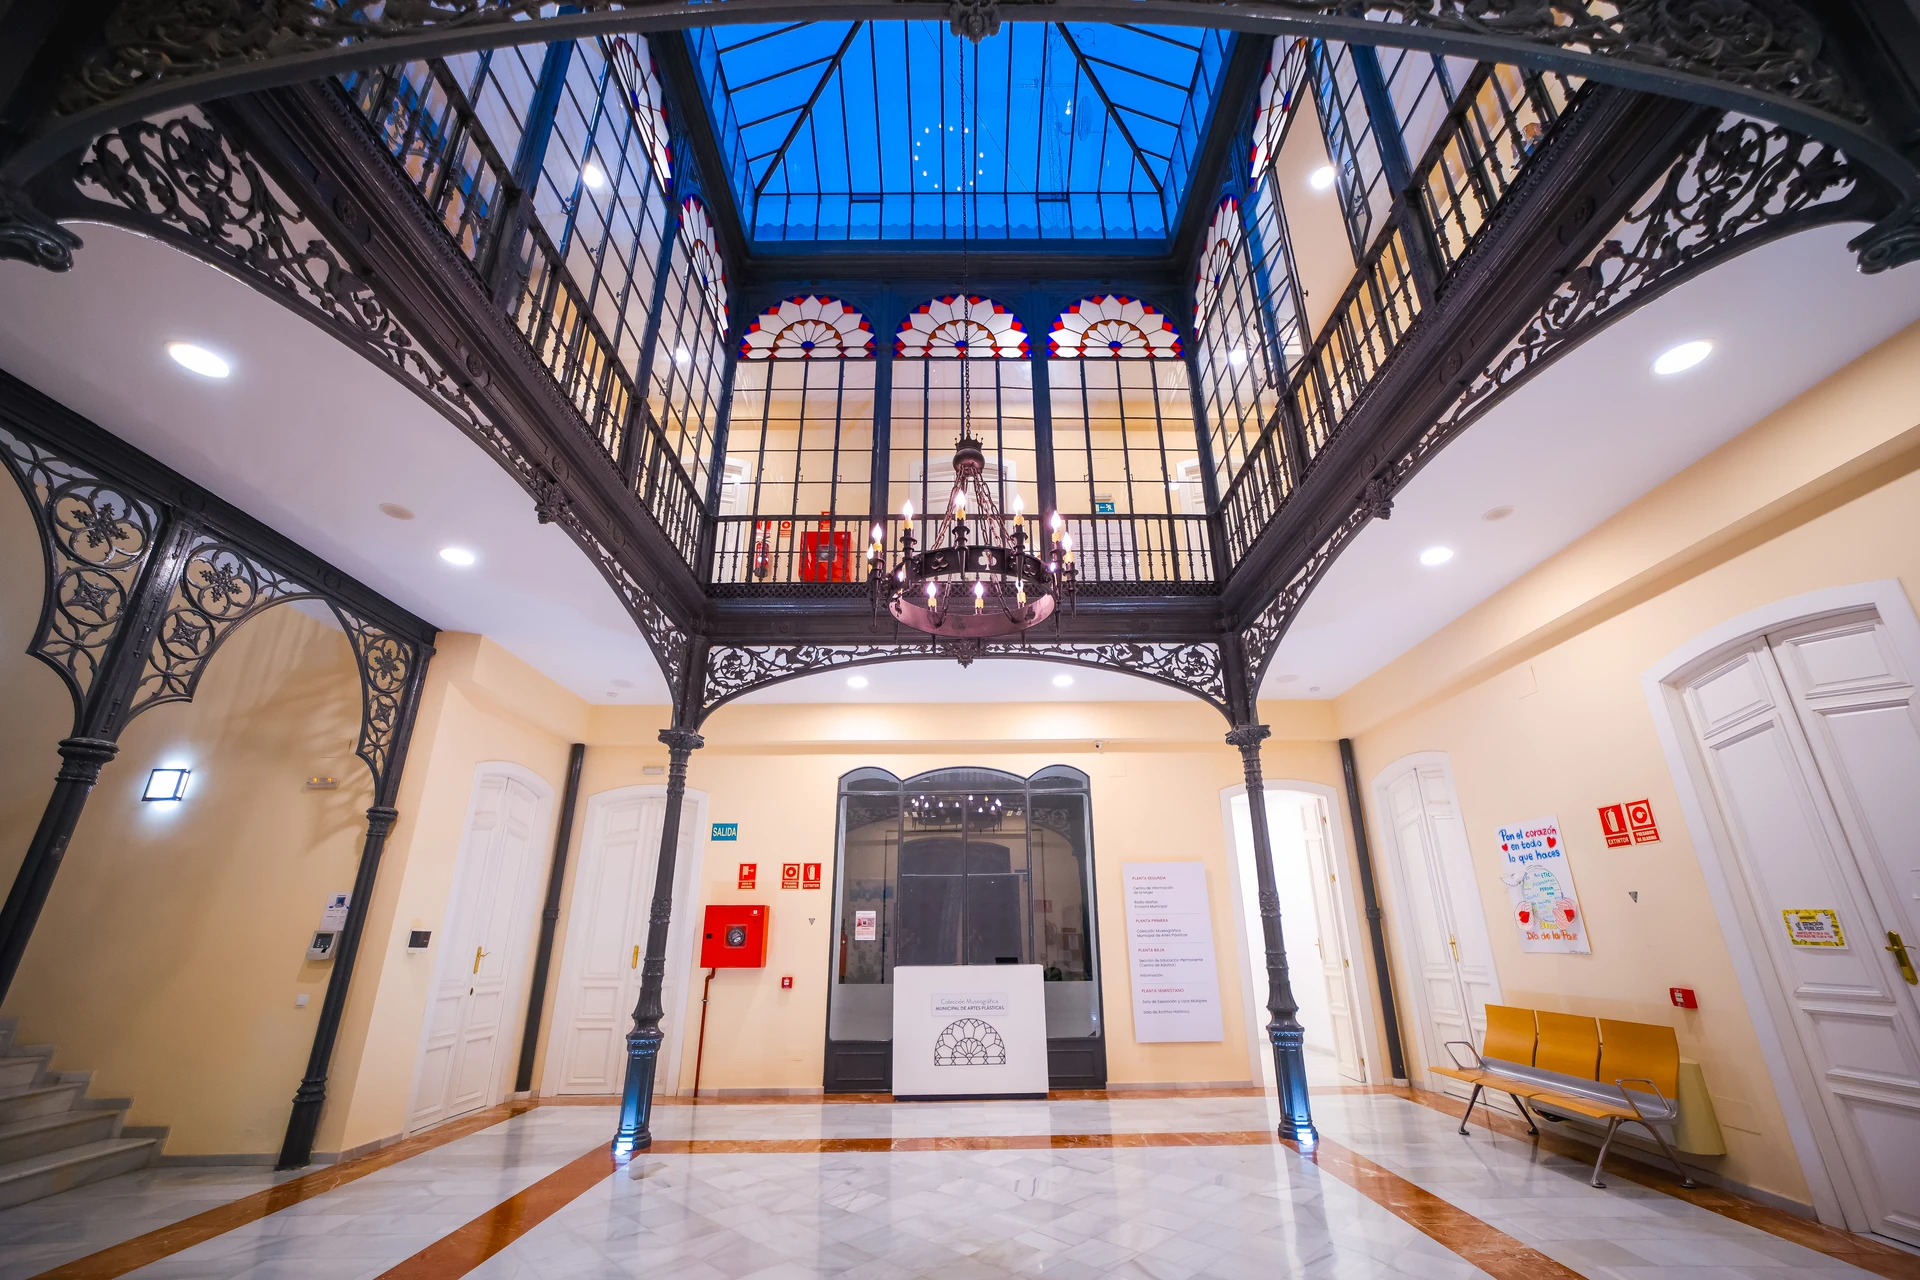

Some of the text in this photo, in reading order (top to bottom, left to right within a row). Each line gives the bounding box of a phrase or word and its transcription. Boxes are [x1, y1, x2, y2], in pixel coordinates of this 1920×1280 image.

[713, 827, 737, 837] SALIDA
[1498, 825, 1557, 842] Pon el corazón
[1521, 839, 1542, 849] todo
[1607, 837, 1629, 845] EXTINTOR
[1508, 850, 1560, 866] lo que haces
[1551, 930, 1561, 939] la
[966, 997, 999, 1005] Museográfica
